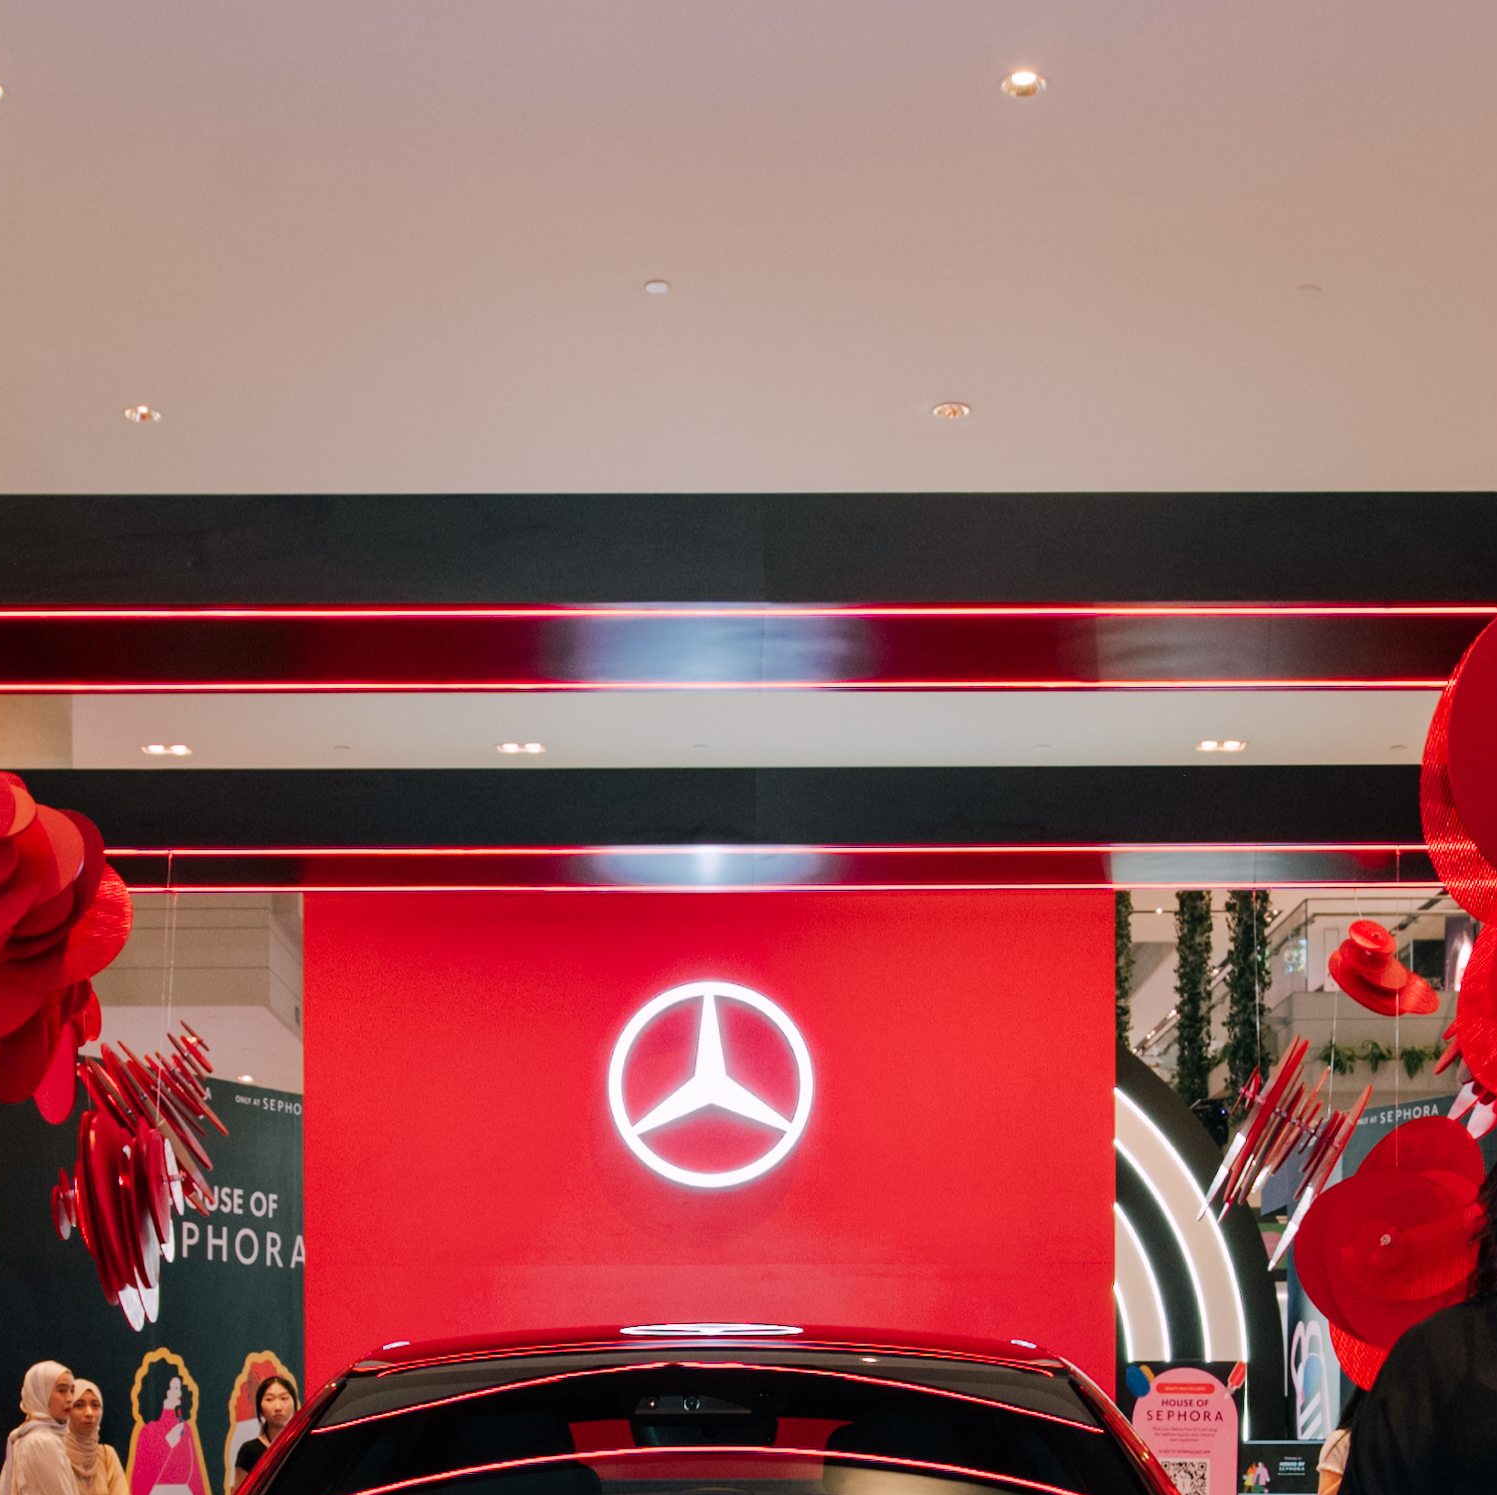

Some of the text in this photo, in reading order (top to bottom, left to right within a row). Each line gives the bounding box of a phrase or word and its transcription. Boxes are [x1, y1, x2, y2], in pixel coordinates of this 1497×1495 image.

[253, 1098, 261, 1106] AT
[263, 1097, 302, 1116] SEPHO
[1380, 1104, 1439, 1124] SEPHORA
[184, 1185, 278, 1219] OUSE OF
[181, 1221, 306, 1269] PHORA
[1161, 1399, 1209, 1407] HOUSE OF
[1146, 1410, 1224, 1422] SEPHORA
